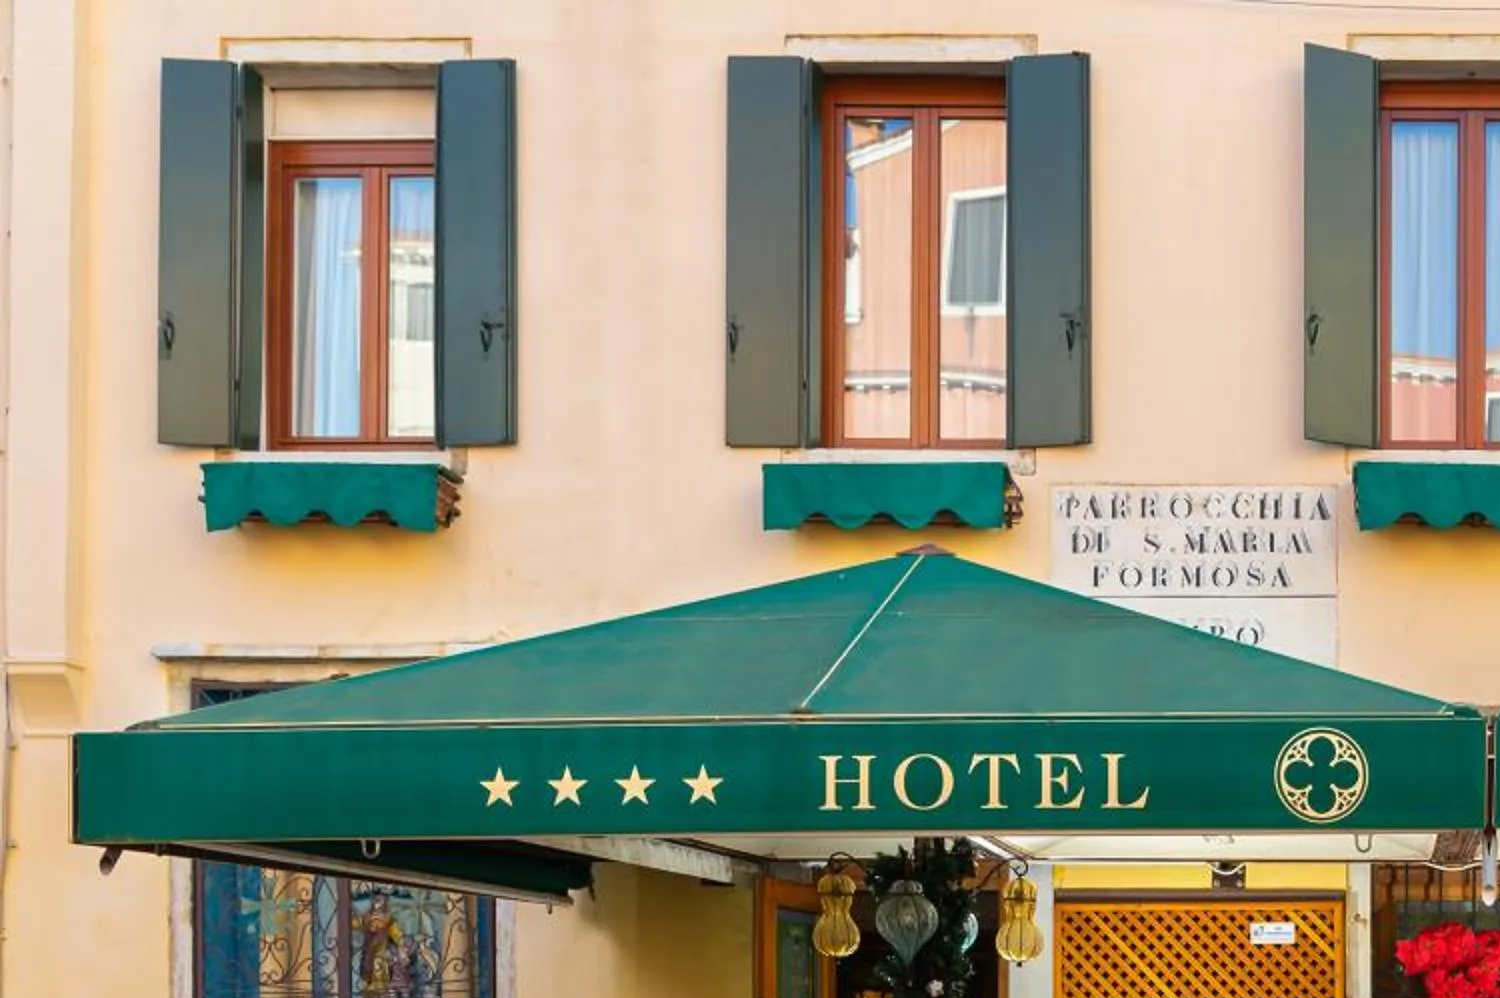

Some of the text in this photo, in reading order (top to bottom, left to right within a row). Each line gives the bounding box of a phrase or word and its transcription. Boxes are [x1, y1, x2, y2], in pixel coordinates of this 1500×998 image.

[1060, 494, 1331, 521] PARROCCHIA
[1071, 531, 1105, 554] DI
[1093, 564, 1293, 588] FORMOSA
[818, 753, 1150, 811] HOTEL
